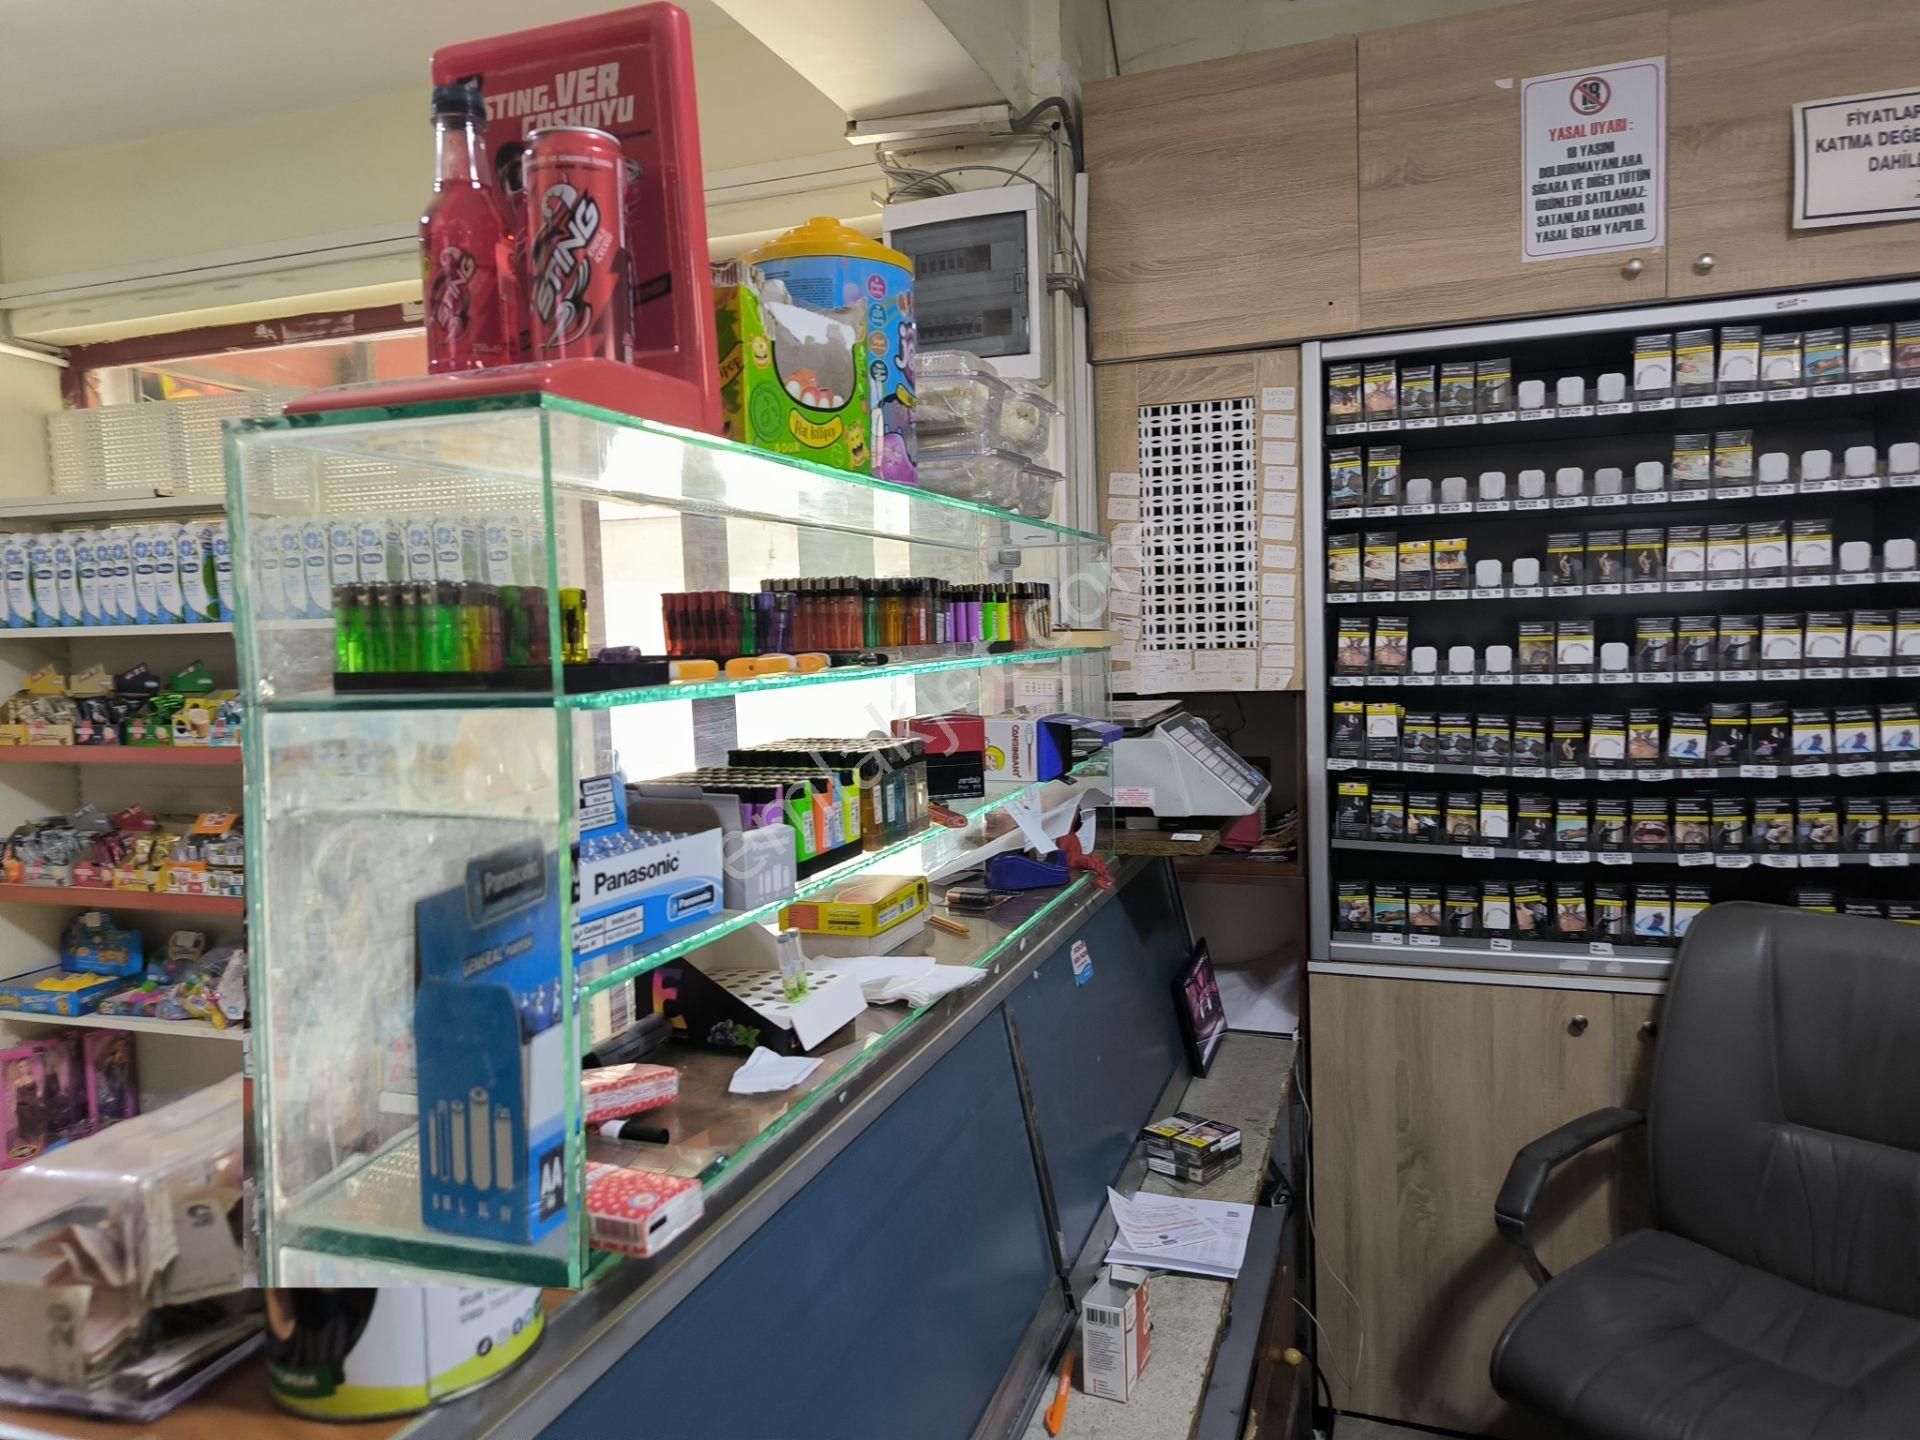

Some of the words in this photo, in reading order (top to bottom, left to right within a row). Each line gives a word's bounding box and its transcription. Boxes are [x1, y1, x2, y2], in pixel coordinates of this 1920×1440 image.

[1549, 124, 1587, 142] YASAL
[1816, 134, 1872, 153] KATMA
[1567, 146, 1577, 158] 18
[1539, 154, 1643, 178] DOLDURMAYANLARA
[1532, 181, 1568, 196] SİGARA
[1571, 178, 1584, 190] VE
[1618, 168, 1651, 184] TÜTÜN
[1537, 210, 1590, 227] SATANLAR
[1593, 202, 1645, 220] HAKKINDA
[1535, 229, 1568, 243] YASAL
[534, 197, 600, 323] STING
[435, 253, 476, 328] STING
[594, 854, 679, 895] Panasonic
